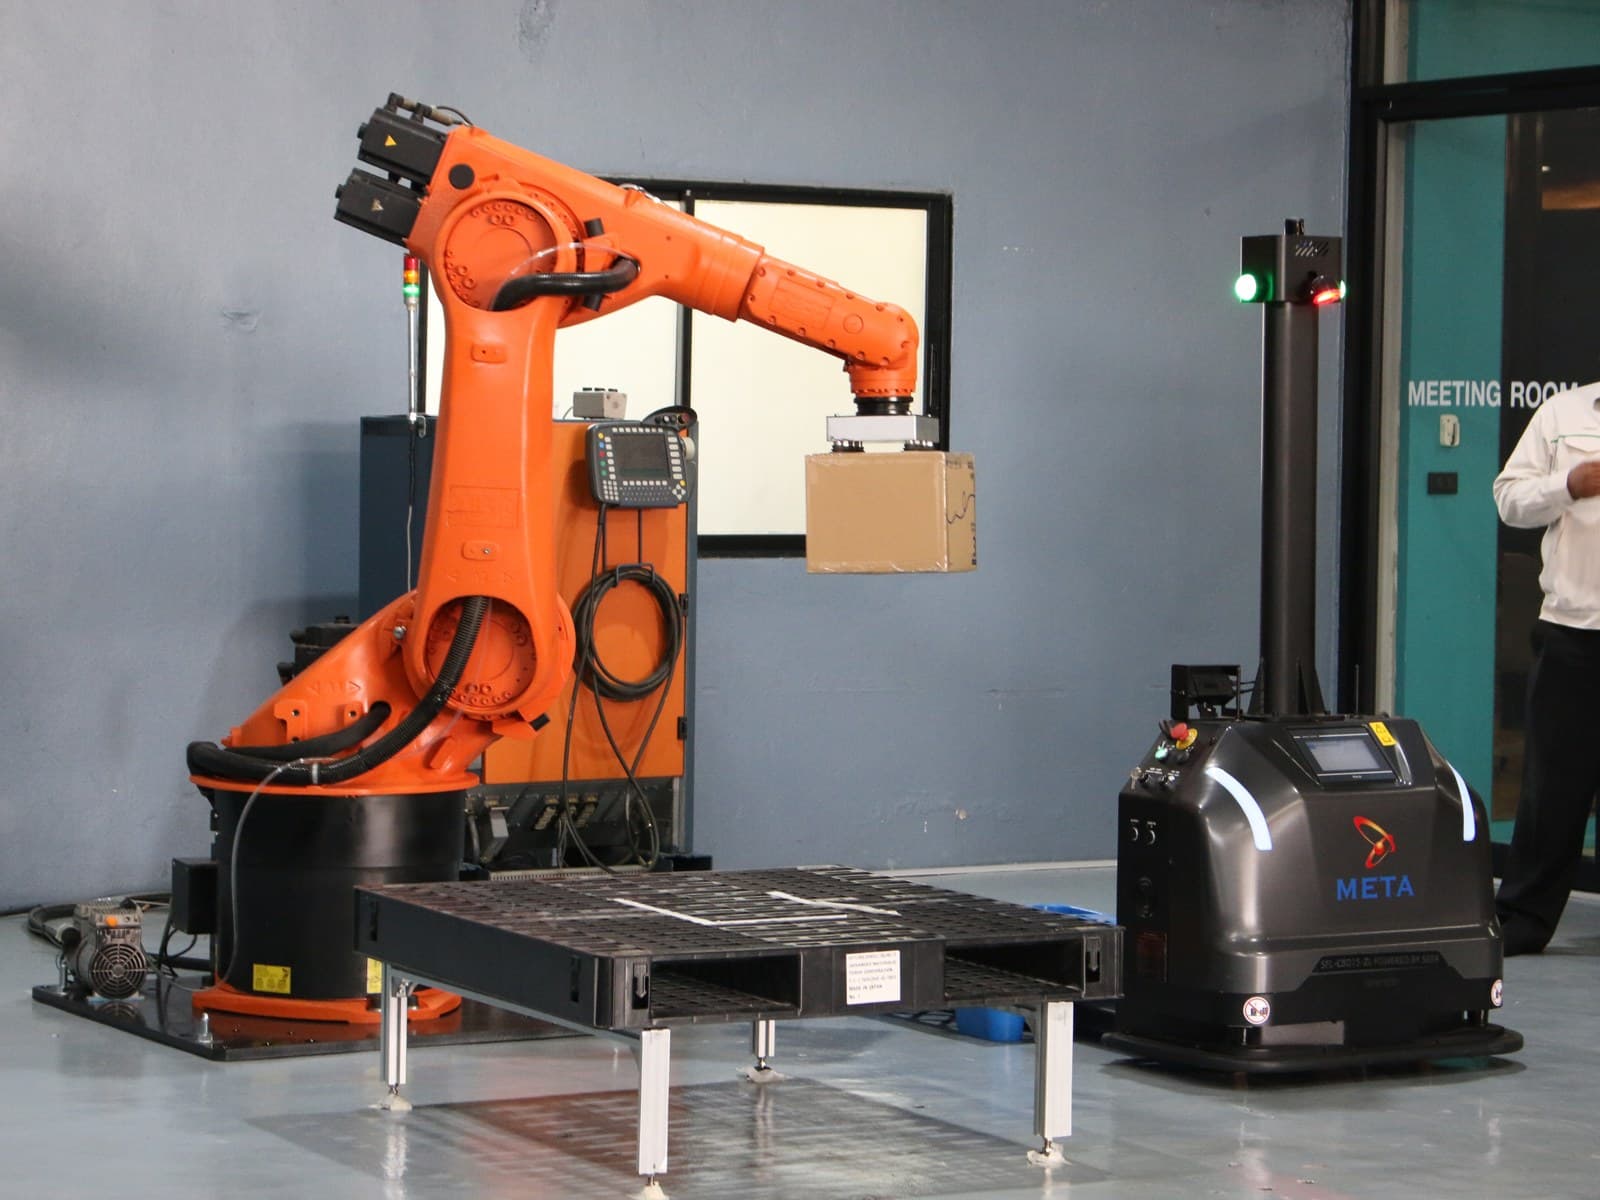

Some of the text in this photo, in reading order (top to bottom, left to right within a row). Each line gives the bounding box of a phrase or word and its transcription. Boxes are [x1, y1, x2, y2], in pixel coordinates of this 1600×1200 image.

[1408, 380, 1579, 408] MEETING ROO
[1336, 875, 1415, 901] META
